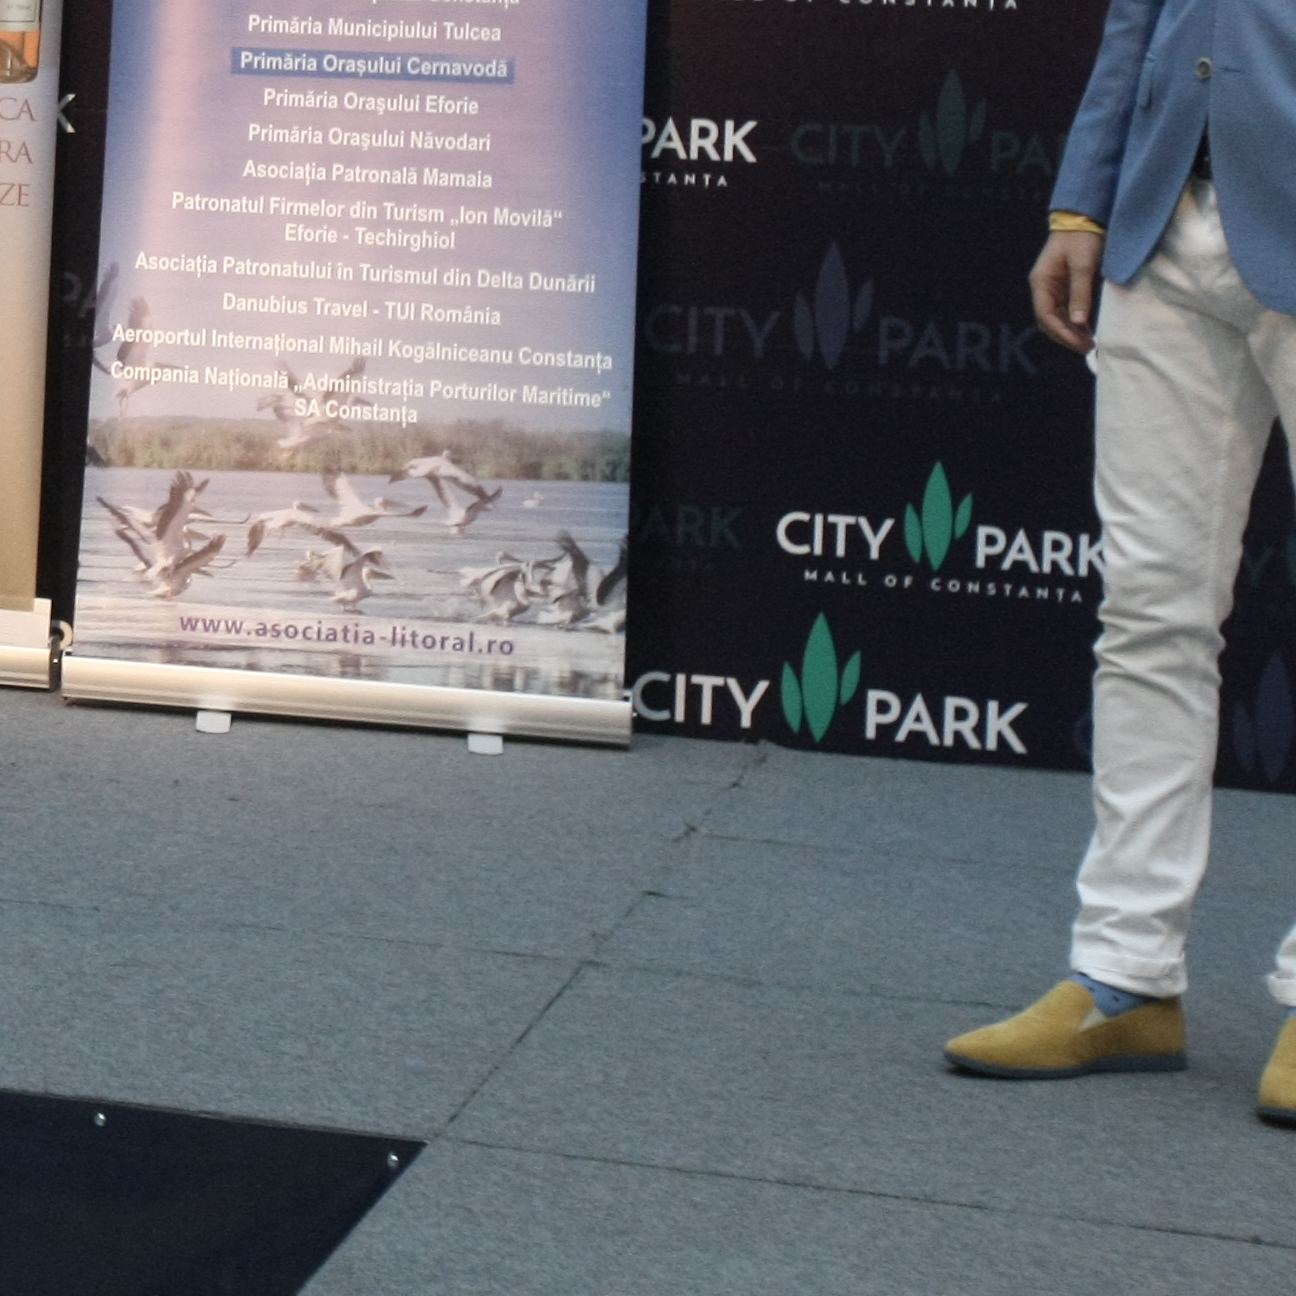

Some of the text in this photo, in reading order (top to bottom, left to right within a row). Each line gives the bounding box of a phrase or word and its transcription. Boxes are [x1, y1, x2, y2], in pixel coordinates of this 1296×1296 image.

[248, 14, 502, 42] Primăria Municipiului Tulcea
[240, 51, 317, 73] Primăria
[407, 57, 509, 79] Cernavodă
[263, 87, 338, 111] Primăria
[426, 94, 480, 116] Eforie
[248, 123, 323, 147] Primăria
[410, 129, 491, 152] Năvodari
[332, 161, 417, 186] Patronală
[423, 167, 493, 189] Mamaia
[172, 191, 264, 215] Patronatul
[269, 195, 345, 219] Firmelor
[351, 199, 378, 221] din
[383, 201, 445, 223] Turism
[284, 223, 456, 253] Eforie Techirghiol
[223, 256, 333, 281] Patronatului
[359, 263, 438, 286] Turismul
[443, 268, 471, 287] din
[477, 269, 524, 290] Delta
[529, 271, 596, 293] Dunării
[223, 291, 501, 326] Danubius Travel TUI România
[112, 323, 206, 351] Aeroportul
[329, 334, 383, 357] Mihail
[388, 338, 513, 368] Kogălniceanu
[110, 360, 199, 388] Compania
[429, 378, 517, 403] Porturilor
[294, 396, 320, 418] SA
[776, 511, 1106, 580] CITY PARK
[803, 569, 868, 587] MALL
[883, 575, 913, 590] OF
[180, 613, 515, 656] www.asociatia-litoral.ro
[632, 671, 1029, 755] CITY PARK
